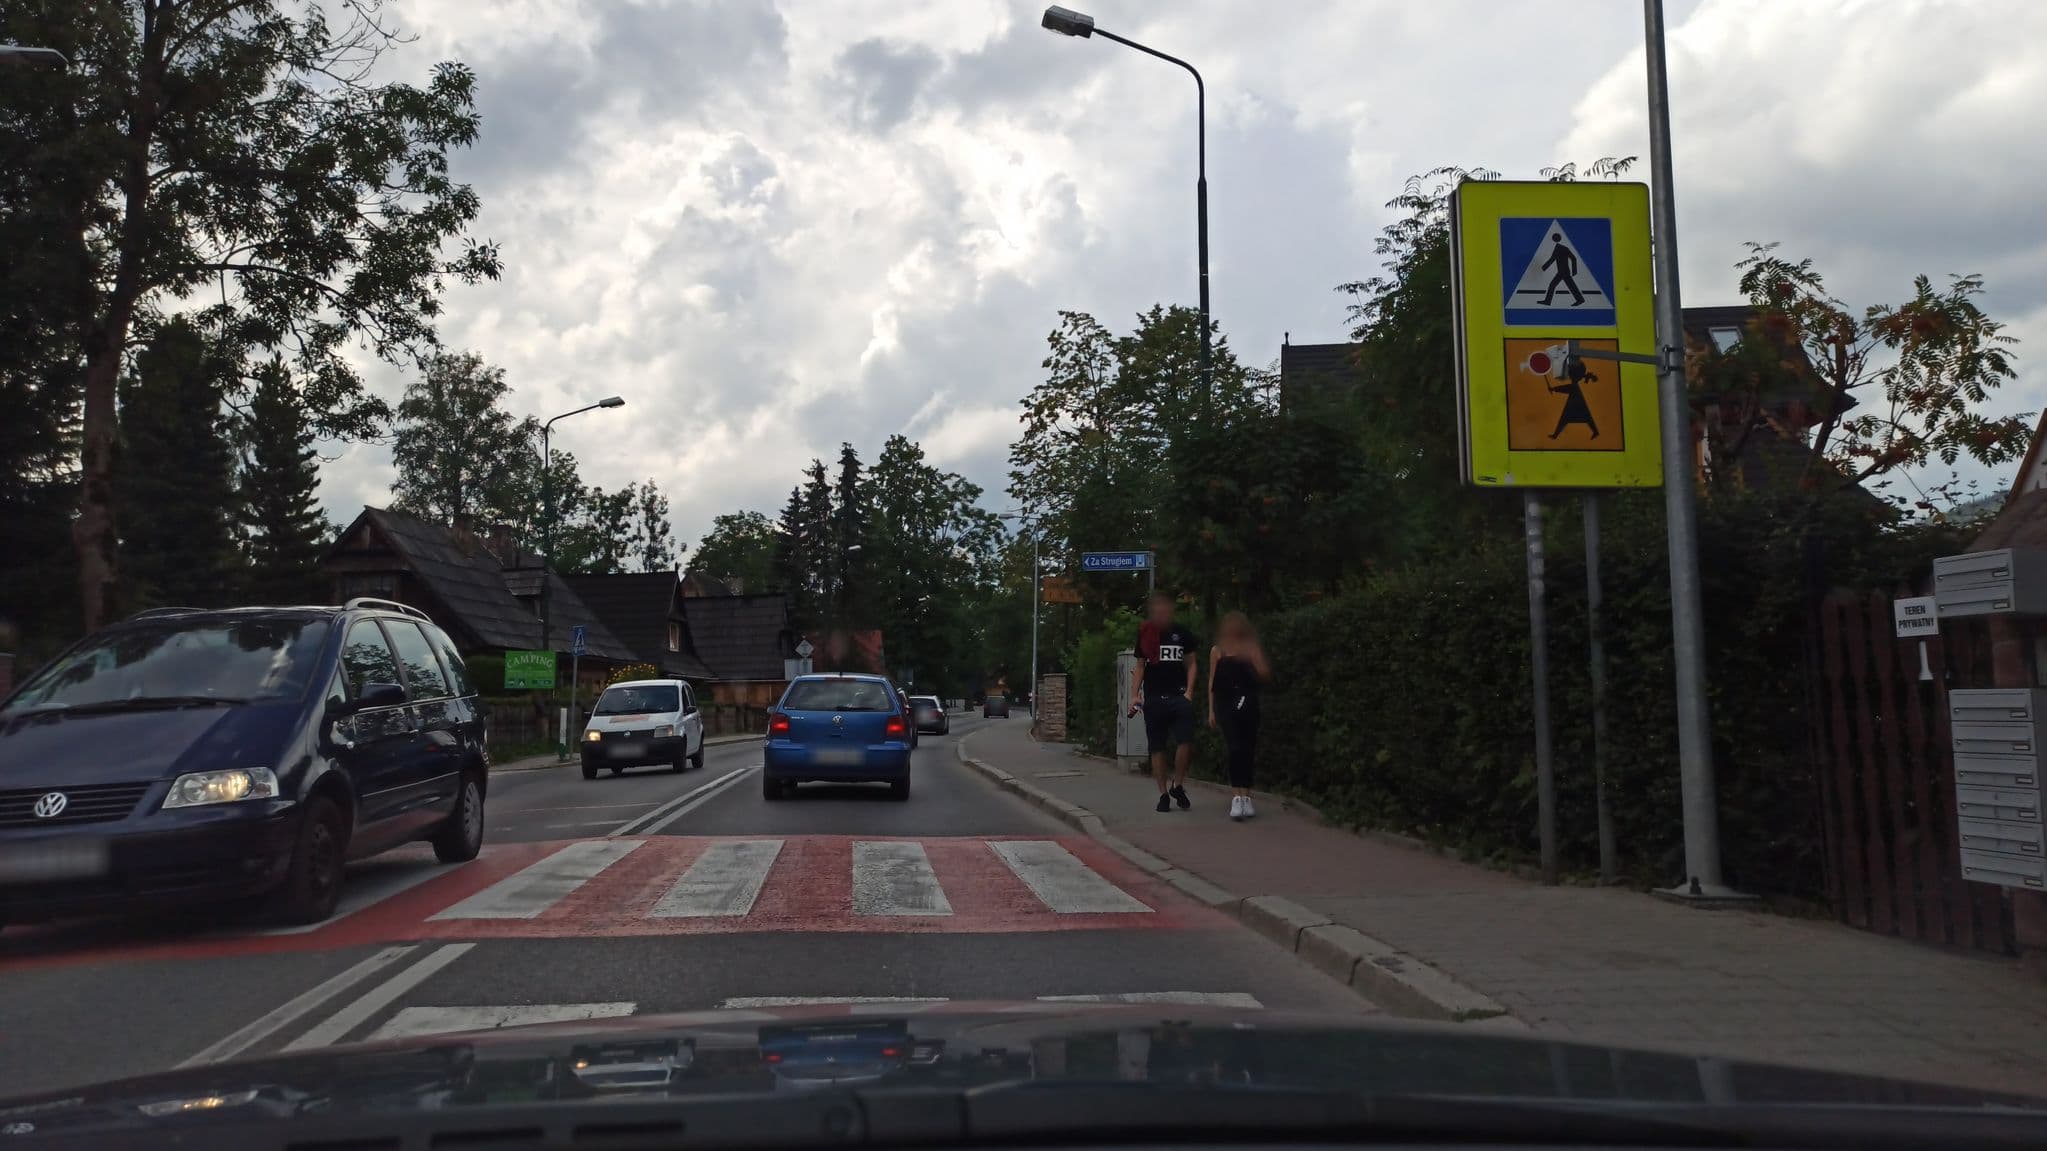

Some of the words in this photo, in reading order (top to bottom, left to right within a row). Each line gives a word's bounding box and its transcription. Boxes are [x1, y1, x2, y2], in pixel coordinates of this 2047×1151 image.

[1091, 557, 1100, 566] Za
[1904, 605, 1926, 615] TEREN
[1898, 617, 1934, 629] PRYWATNY
[507, 654, 553, 668] CAMPING
